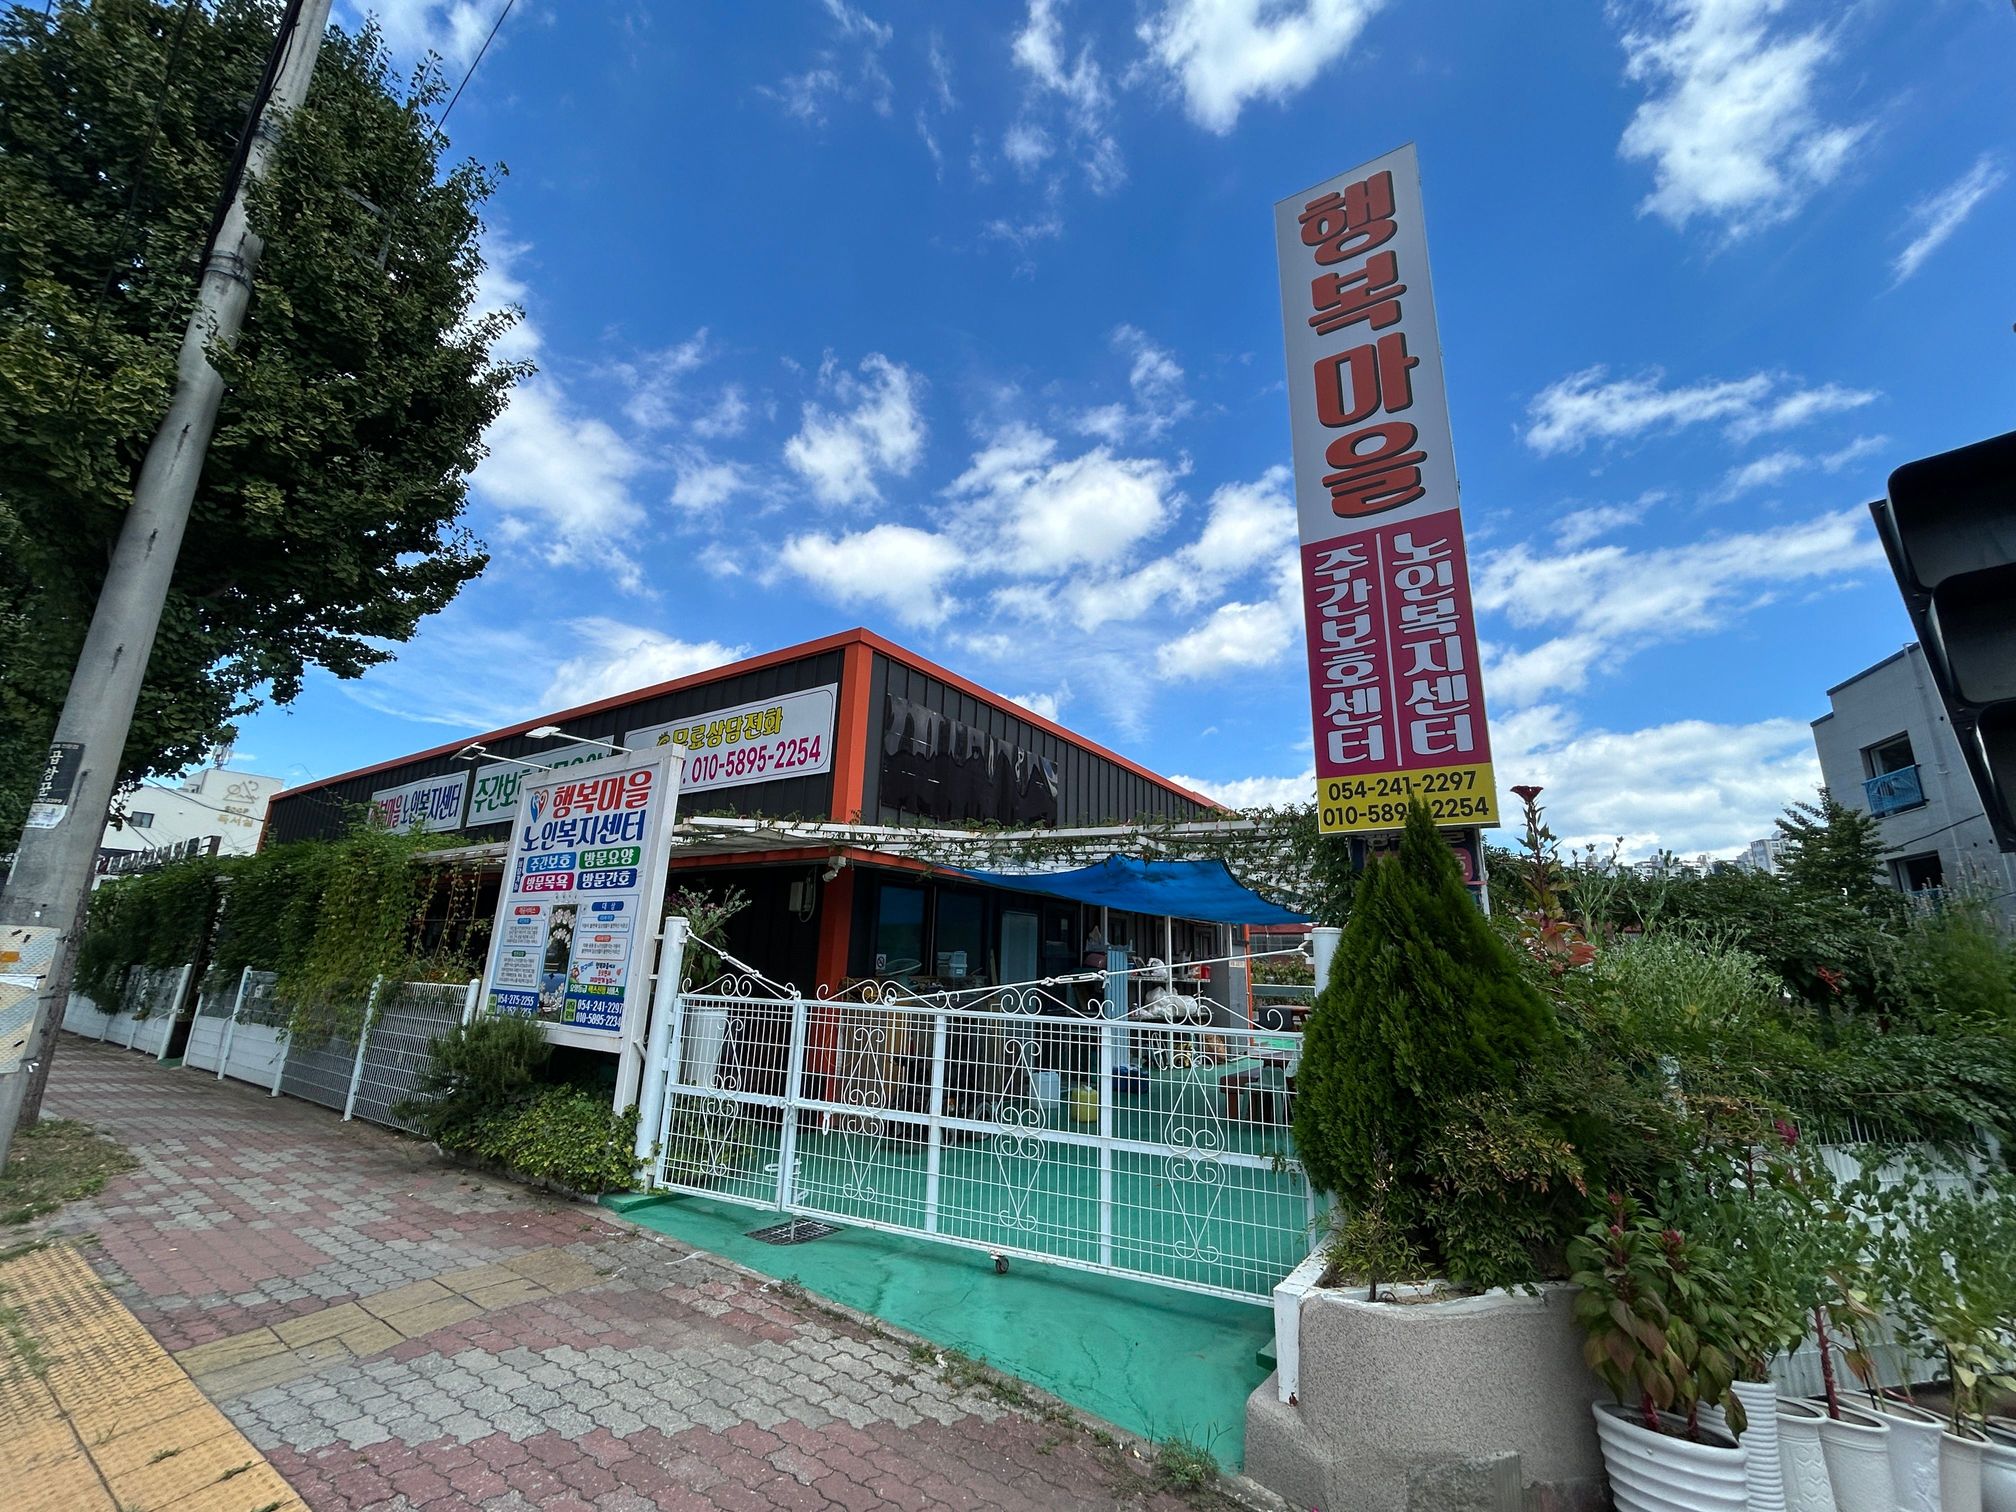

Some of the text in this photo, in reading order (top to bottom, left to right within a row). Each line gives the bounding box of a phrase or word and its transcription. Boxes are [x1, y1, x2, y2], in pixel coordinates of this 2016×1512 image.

[1298, 170, 1428, 519] 행복마을
[1313, 543, 1386, 764] 주간보호센터
[1391, 531, 1475, 756] 노인복지센터
[672, 706, 783, 750] 무료상담전화
[691, 735, 821, 783] 010-5895-2254
[401, 782, 463, 824] 노인복지센터
[553, 770, 653, 819] 행복마을
[1328, 770, 1476, 801] 054-241-2297
[520, 809, 647, 852] 노인복지센터
[1323, 796, 1489, 827] 010-5892254
[530, 854, 571, 871] 주간보호
[584, 848, 634, 868] 방문요양
[525, 873, 568, 891] 방문목욕
[582, 870, 631, 889] 방문간호
[577, 999, 624, 1014] 054-241-2297
